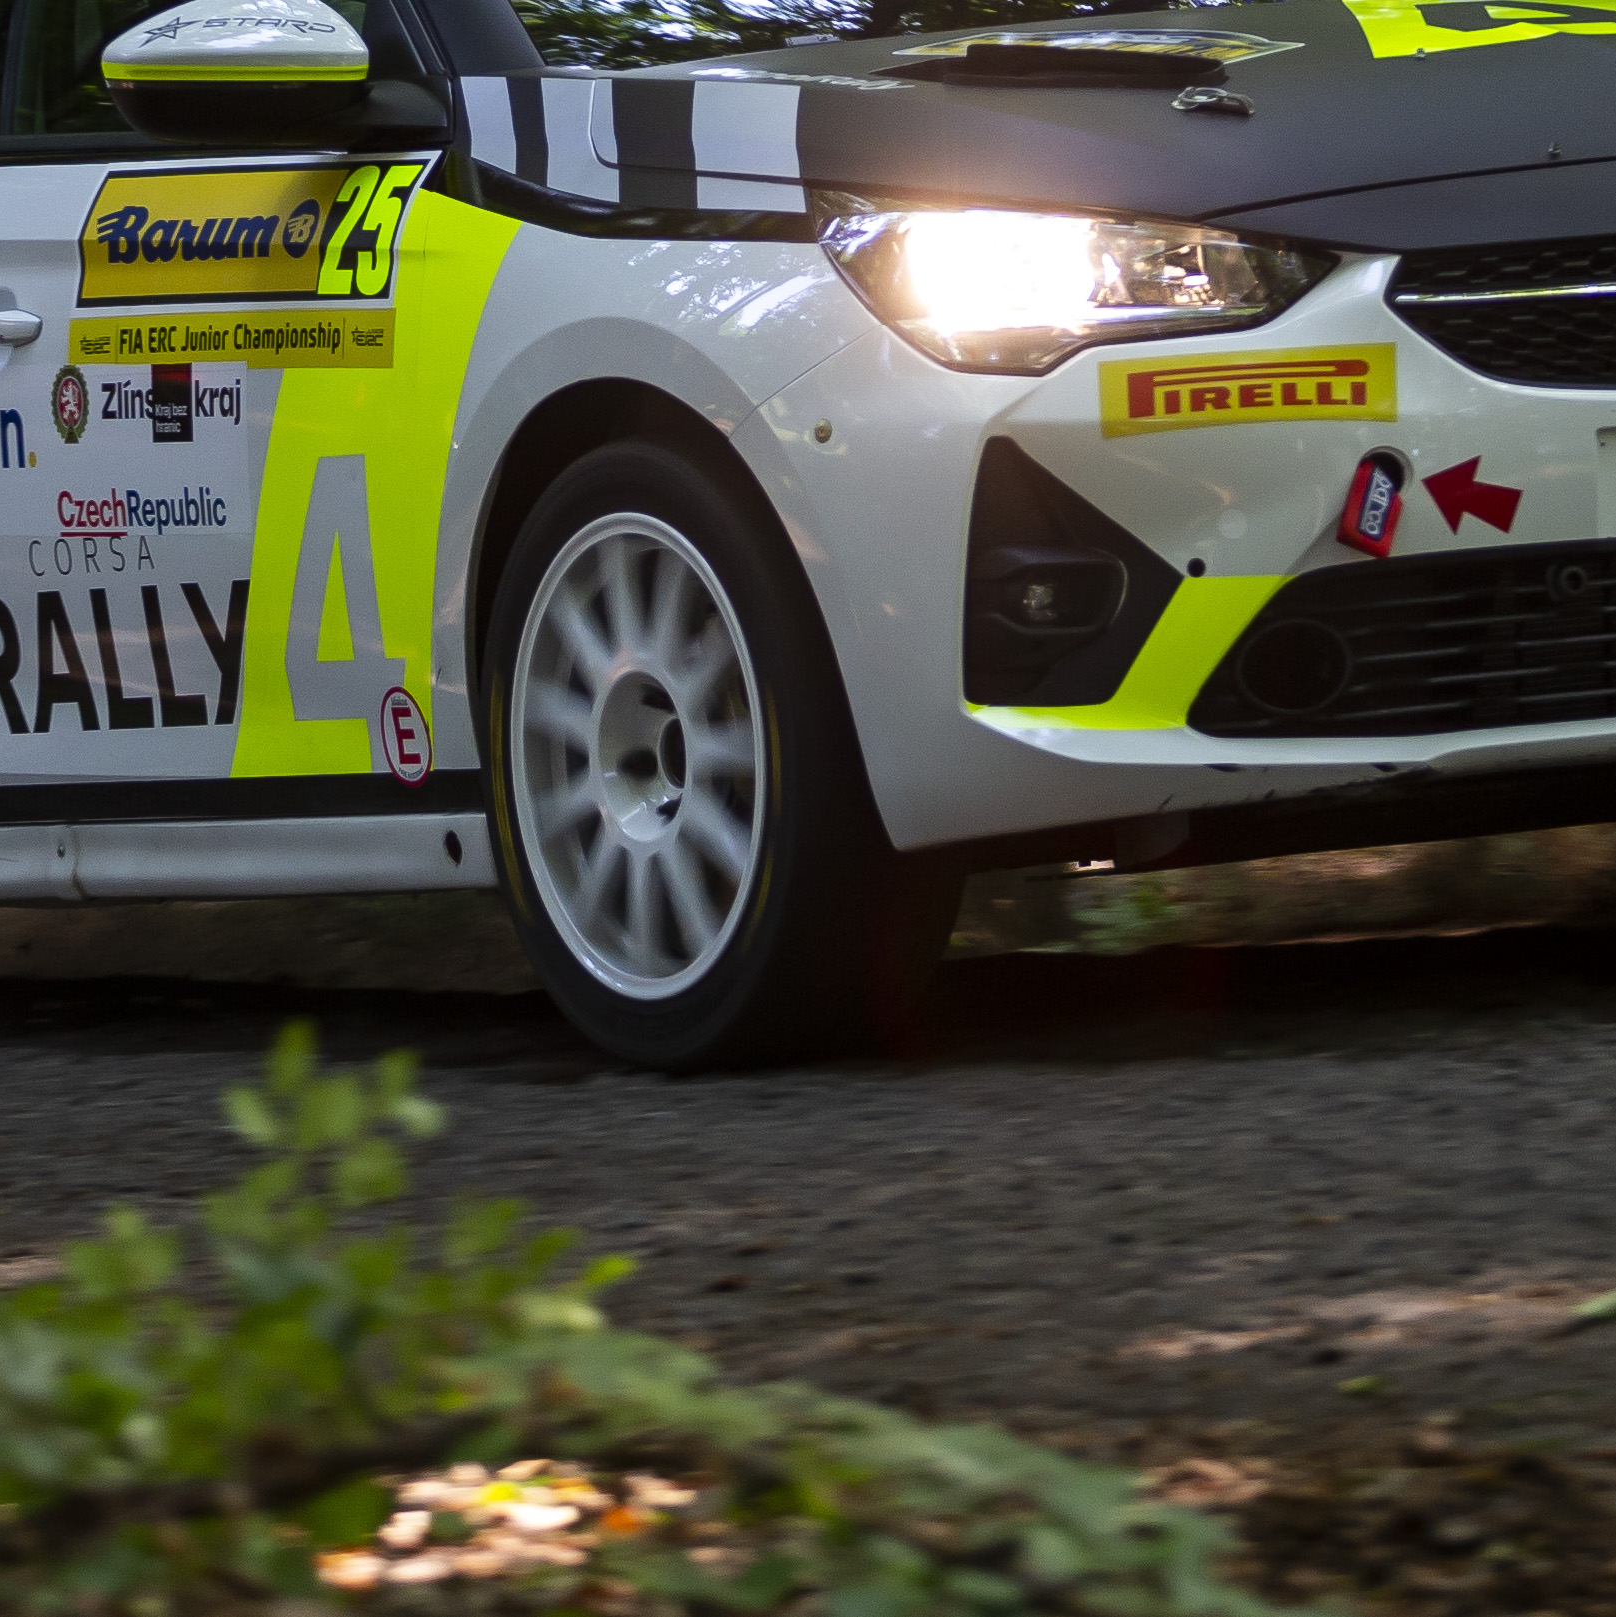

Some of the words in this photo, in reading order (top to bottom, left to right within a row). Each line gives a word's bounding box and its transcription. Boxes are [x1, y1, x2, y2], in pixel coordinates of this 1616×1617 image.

[202, 16, 337, 34] STARD
[96, 205, 281, 265] Barum
[317, 164, 425, 296] 25
[118, 327, 144, 355] FIA
[147, 325, 177, 354] ERC
[180, 323, 230, 352] Junior
[233, 322, 341, 355] Championship
[194, 378, 242, 426] kraj
[1126, 358, 1371, 419] PIRELLI
[28, 535, 156, 577] CORSA
[285, 454, 406, 772] 4
[390, 706, 422, 765] E
